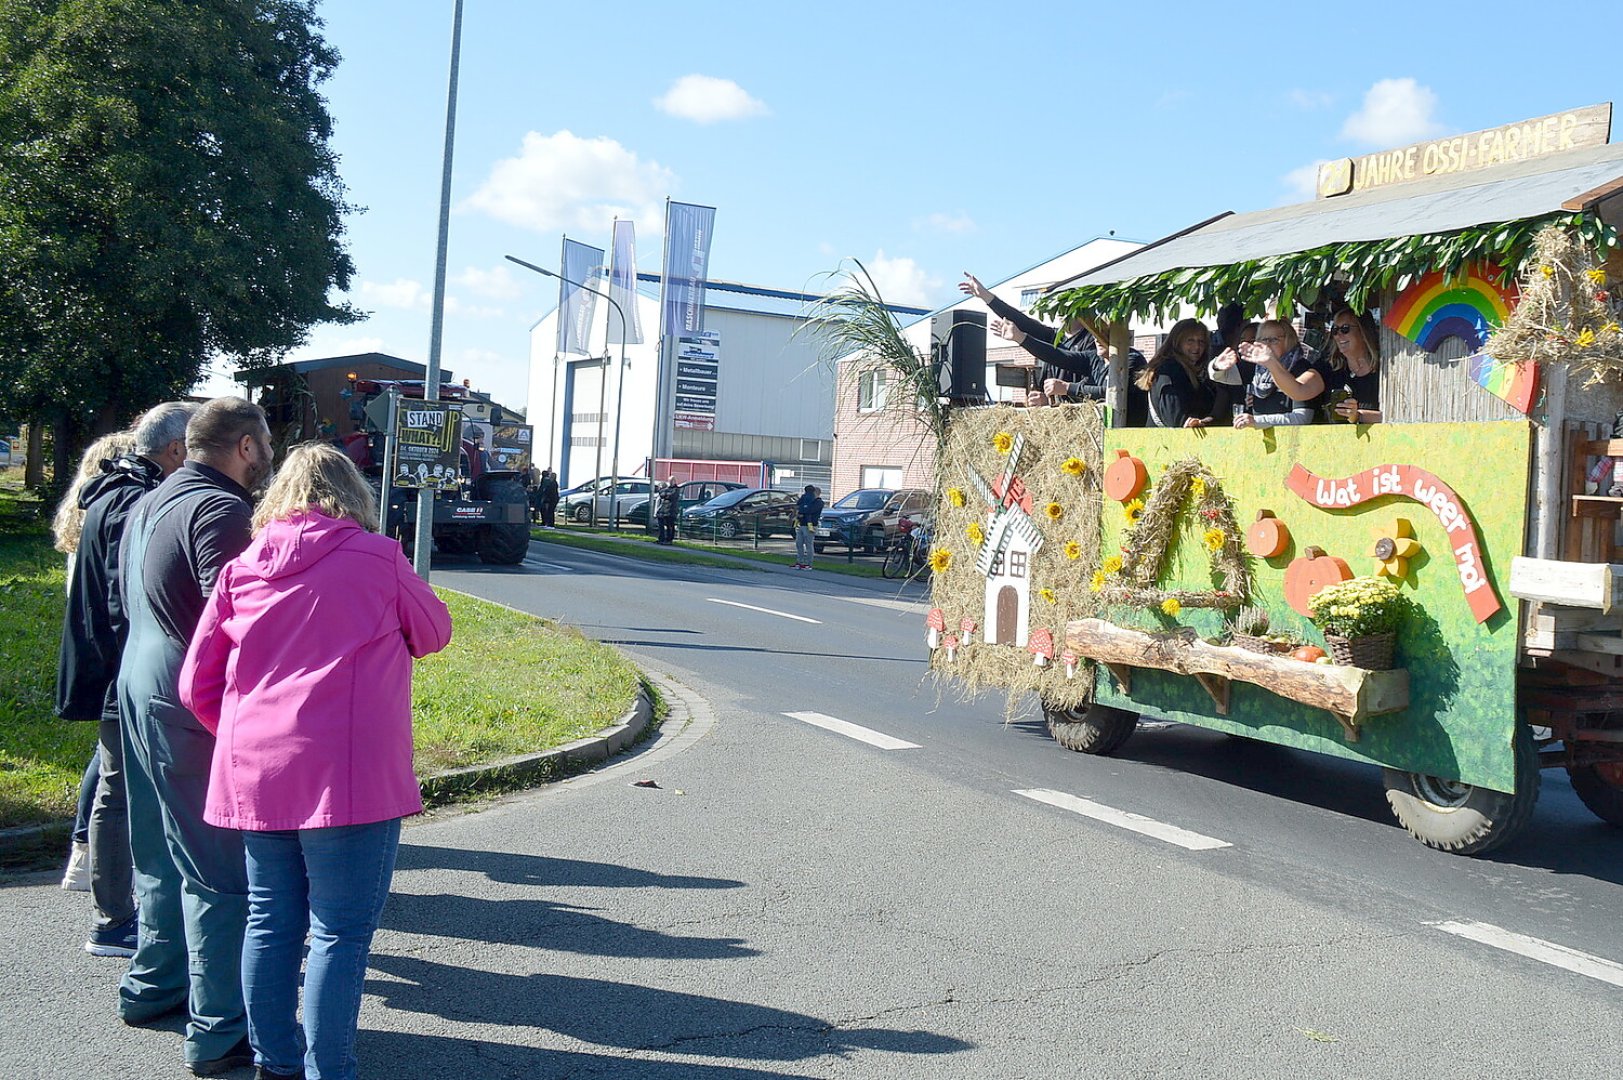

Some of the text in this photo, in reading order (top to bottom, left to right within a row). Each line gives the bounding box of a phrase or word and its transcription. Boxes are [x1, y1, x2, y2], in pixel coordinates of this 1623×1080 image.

[1354, 147, 1417, 190] JAHRE
[409, 410, 460, 453] STAND UP
[1316, 479, 1361, 506] Wat
[1372, 464, 1403, 496] ist
[1413, 478, 1468, 534] weer
